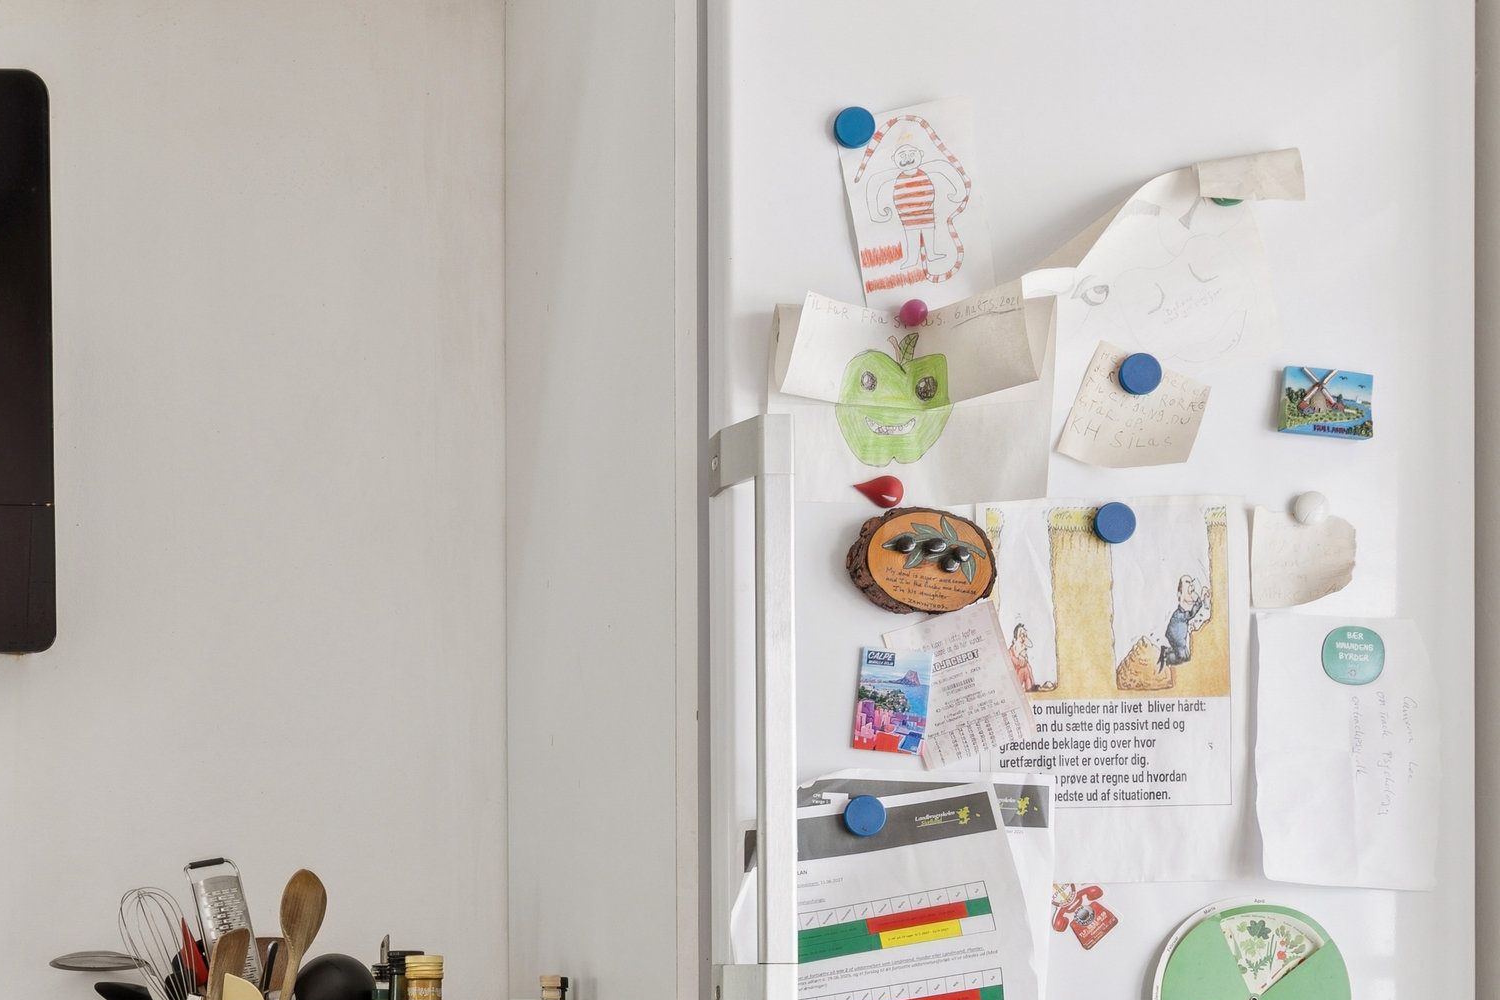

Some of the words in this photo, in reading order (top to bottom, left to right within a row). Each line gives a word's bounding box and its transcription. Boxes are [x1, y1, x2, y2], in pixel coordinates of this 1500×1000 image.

[867, 651, 895, 661] CALPE
[1033, 705, 1043, 715] to
[1046, 702, 1100, 717] muligheder
[1103, 702, 1118, 714] når
[1121, 701, 1142, 713] livet
[1147, 700, 1175, 713] bliver
[1177, 699, 1206, 712] hårdt:
[1036, 722, 1048, 733] an
[1051, 721, 1063, 732] du
[1066, 719, 1093, 732] sætte
[1096, 719, 1110, 734] dig
[1113, 718, 1149, 733] passivt
[1151, 718, 1170, 730] ned
[1173, 719, 1185, 732] og
[1000, 739, 1050, 754] grædende
[1052, 738, 1090, 752] beklage
[1093, 737, 1108, 751] dig
[1110, 739, 1132, 749] over
[1134, 736, 1156, 748] hvor
[1000, 755, 1057, 770] uretfærdigt
[1059, 755, 1079, 767] livet
[1082, 757, 1092, 766] er
[1094, 754, 1129, 766] overfor
[1131, 753, 1149, 768] dig.
[1060, 773, 1088, 787] prøve
[1090, 773, 1099, 783] at
[1101, 773, 1130, 786] regne
[1132, 771, 1144, 783] ud
[1146, 770, 1187, 782] hvordan
[1086, 789, 1098, 801] ud
[1100, 789, 1111, 801] af
[1113, 788, 1171, 801] situationen.
